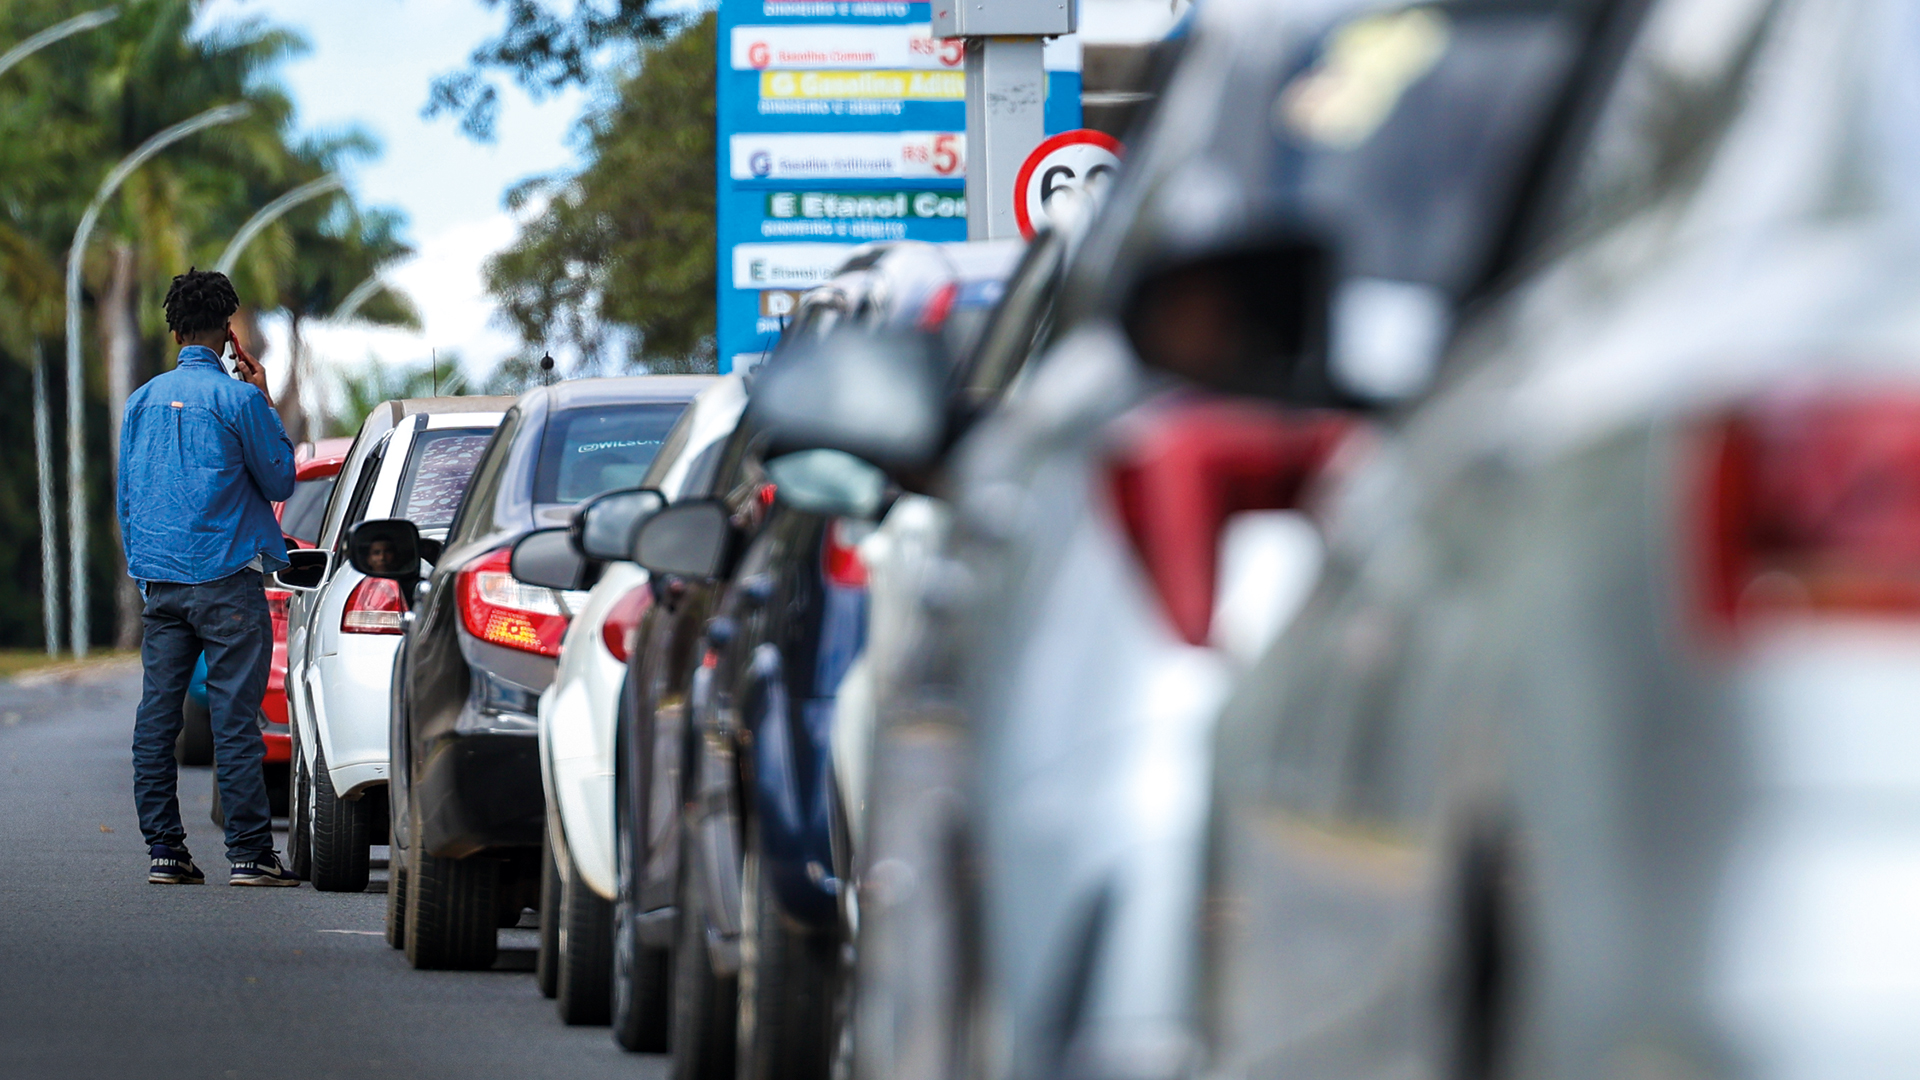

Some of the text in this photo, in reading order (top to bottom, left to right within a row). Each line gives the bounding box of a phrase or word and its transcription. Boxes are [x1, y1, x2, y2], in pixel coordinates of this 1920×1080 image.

[748, 41, 770, 69] G
[749, 151, 772, 177] G
[771, 192, 797, 217] E
[801, 192, 908, 218] Etanol
[750, 259, 766, 281] E
[159, 858, 169, 866] DO
